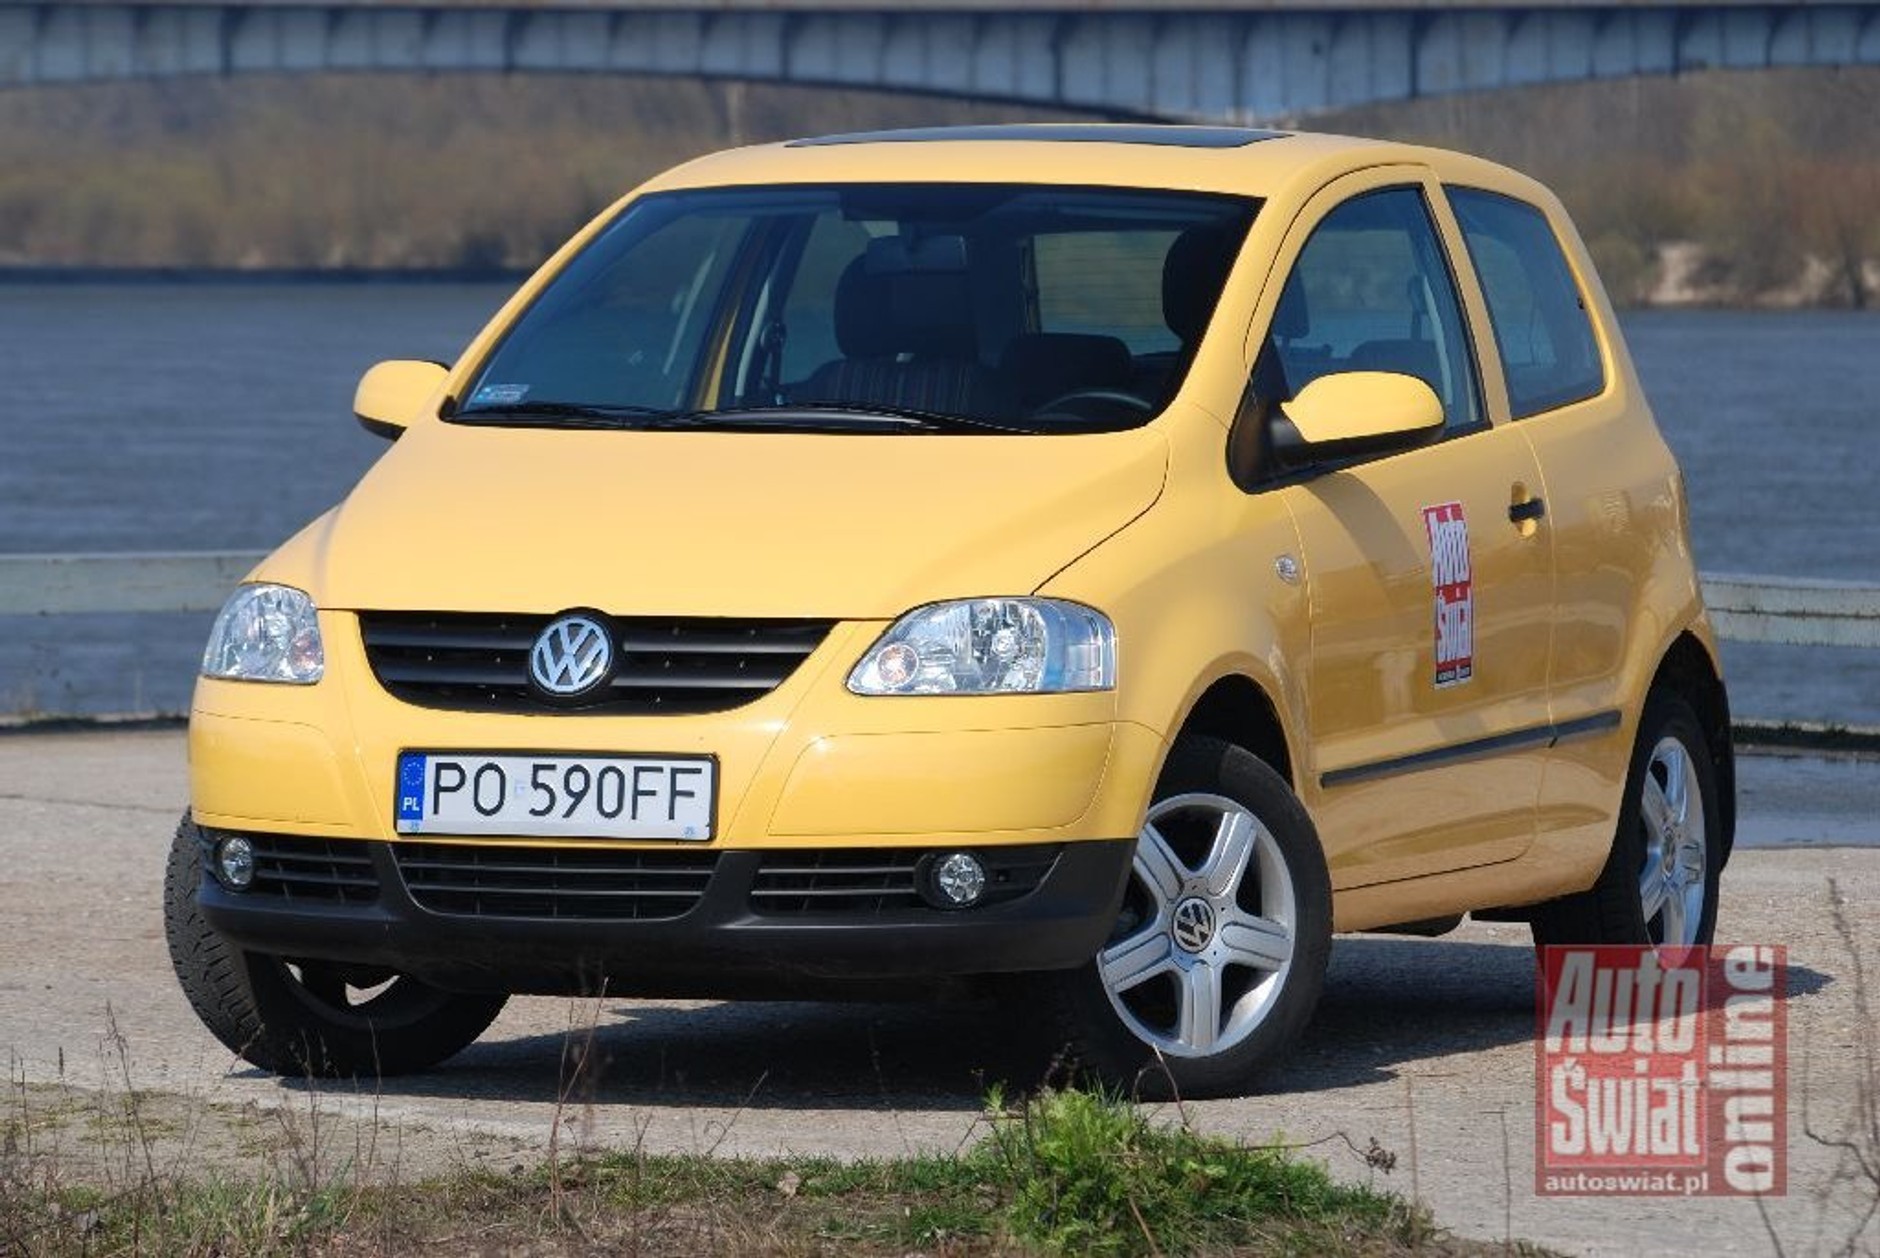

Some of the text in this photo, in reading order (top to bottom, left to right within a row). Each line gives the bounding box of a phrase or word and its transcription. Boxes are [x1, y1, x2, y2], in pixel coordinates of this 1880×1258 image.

[1428, 507, 1470, 587] Auto
[532, 618, 610, 692] VW
[402, 796, 420, 811] PL
[433, 762, 702, 820] PO 590FF
